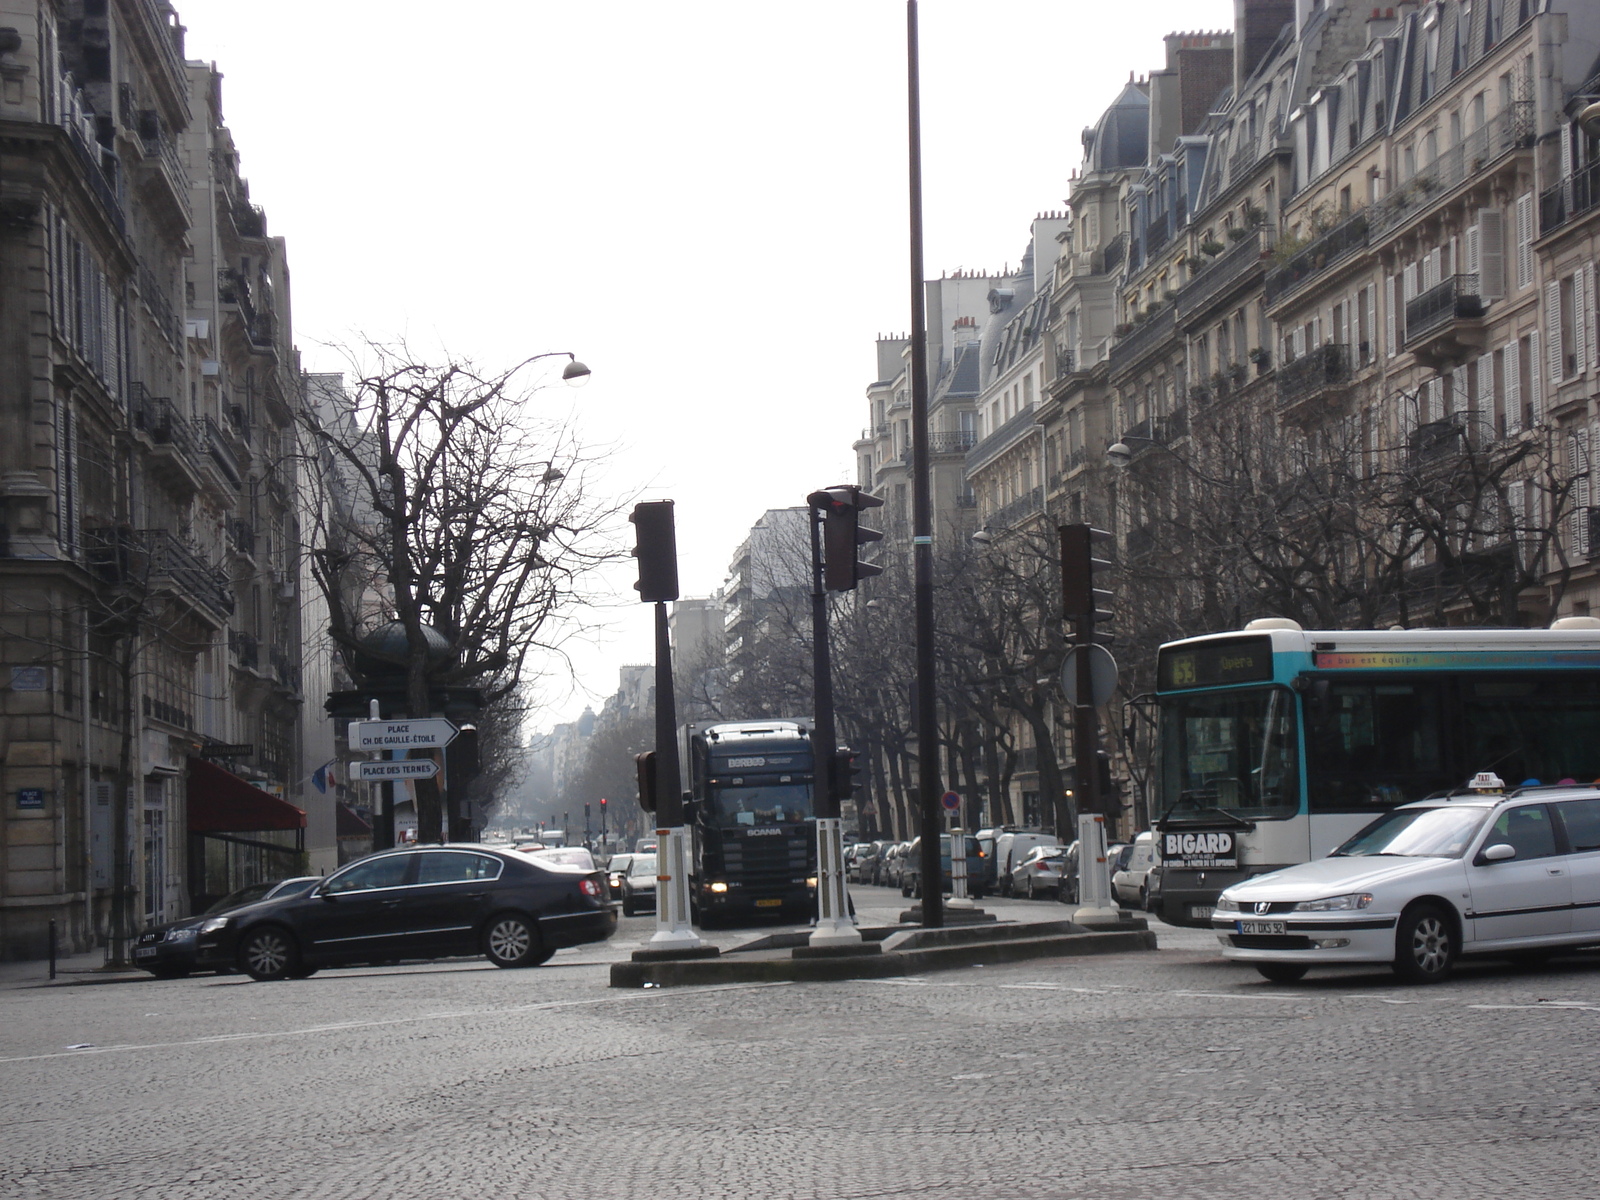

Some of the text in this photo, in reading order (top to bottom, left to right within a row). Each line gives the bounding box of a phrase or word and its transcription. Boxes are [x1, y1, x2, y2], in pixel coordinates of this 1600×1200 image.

[1339, 656, 1355, 664] bus
[1361, 656, 1376, 664] est
[387, 725, 409, 733] PLACE
[374, 736, 383, 745] DE
[363, 765, 431, 776] PLACE DES TERNES
[1477, 774, 1490, 782] TAXI
[747, 828, 782, 837] SCANIA
[1166, 833, 1232, 855] BIGARD
[1243, 923, 1256, 933] 221
[1274, 923, 1283, 934] 92
